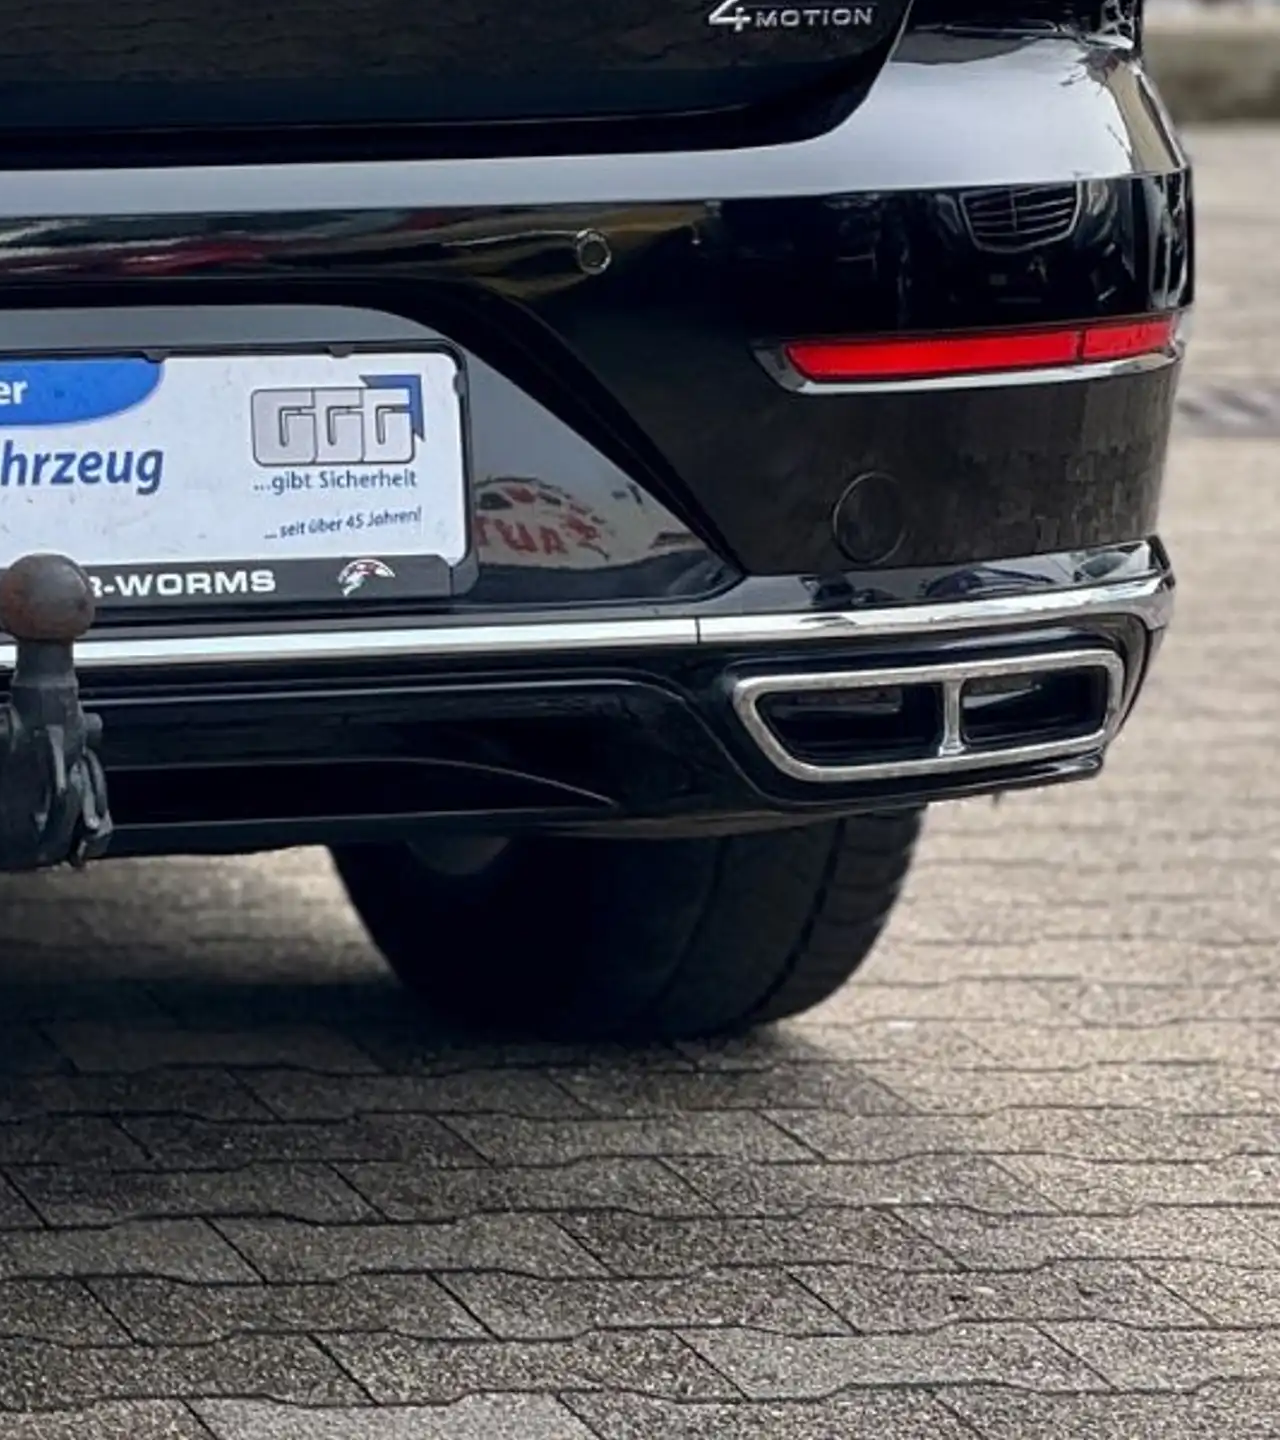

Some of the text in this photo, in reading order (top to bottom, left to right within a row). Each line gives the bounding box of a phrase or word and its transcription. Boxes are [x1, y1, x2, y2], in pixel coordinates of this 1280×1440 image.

[319, 468, 418, 490] Sicherheit
[280, 522, 306, 539] seit
[308, 517, 343, 534] über
[345, 512, 366, 530] 45
[367, 506, 422, 528] Jahren!
